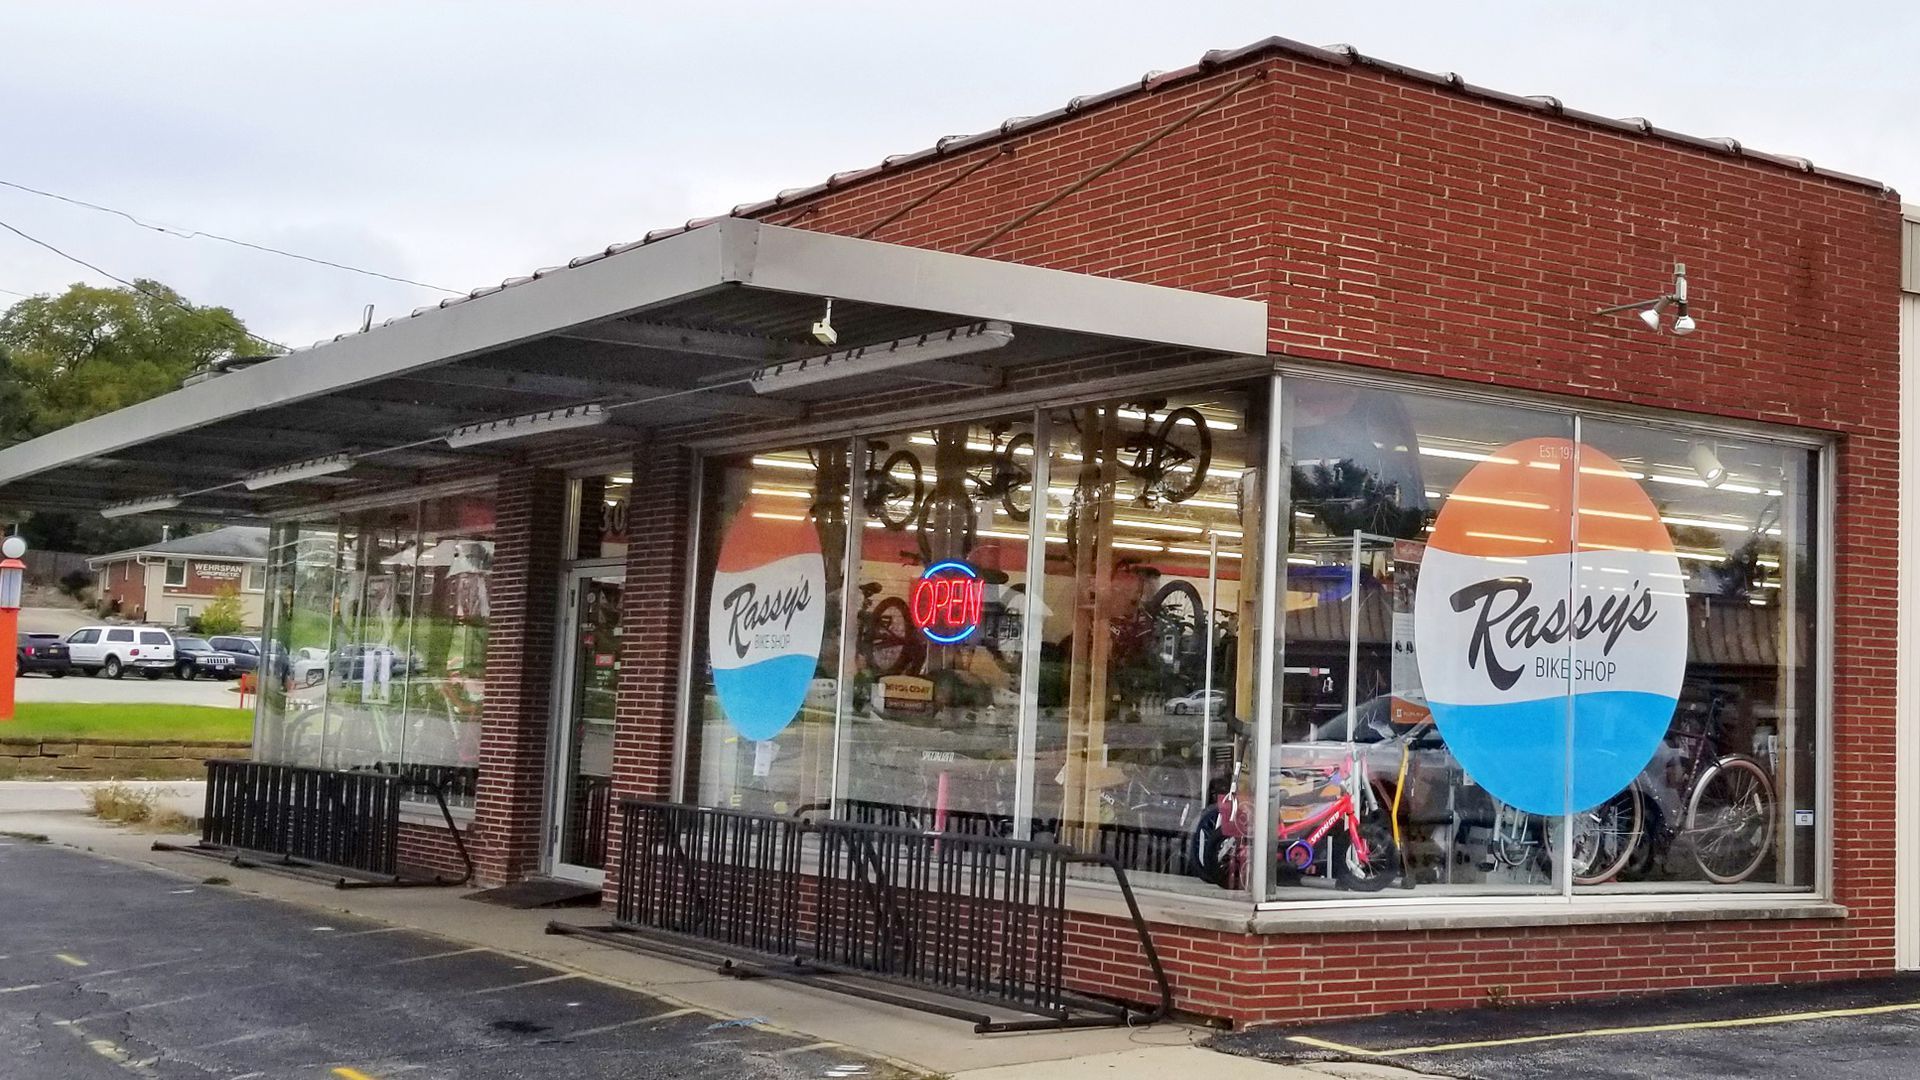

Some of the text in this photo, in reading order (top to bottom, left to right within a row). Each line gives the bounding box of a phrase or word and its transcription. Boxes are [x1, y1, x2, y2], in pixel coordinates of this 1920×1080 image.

[195, 563, 242, 573] WEHRSPAN
[723, 573, 812, 659] Rassy's
[914, 579, 985, 625] OPEN
[754, 633, 791, 649] BIKE SHOP
[1450, 576, 1658, 691] Rassy's
[1535, 656, 1617, 683] BIKE SHOP
